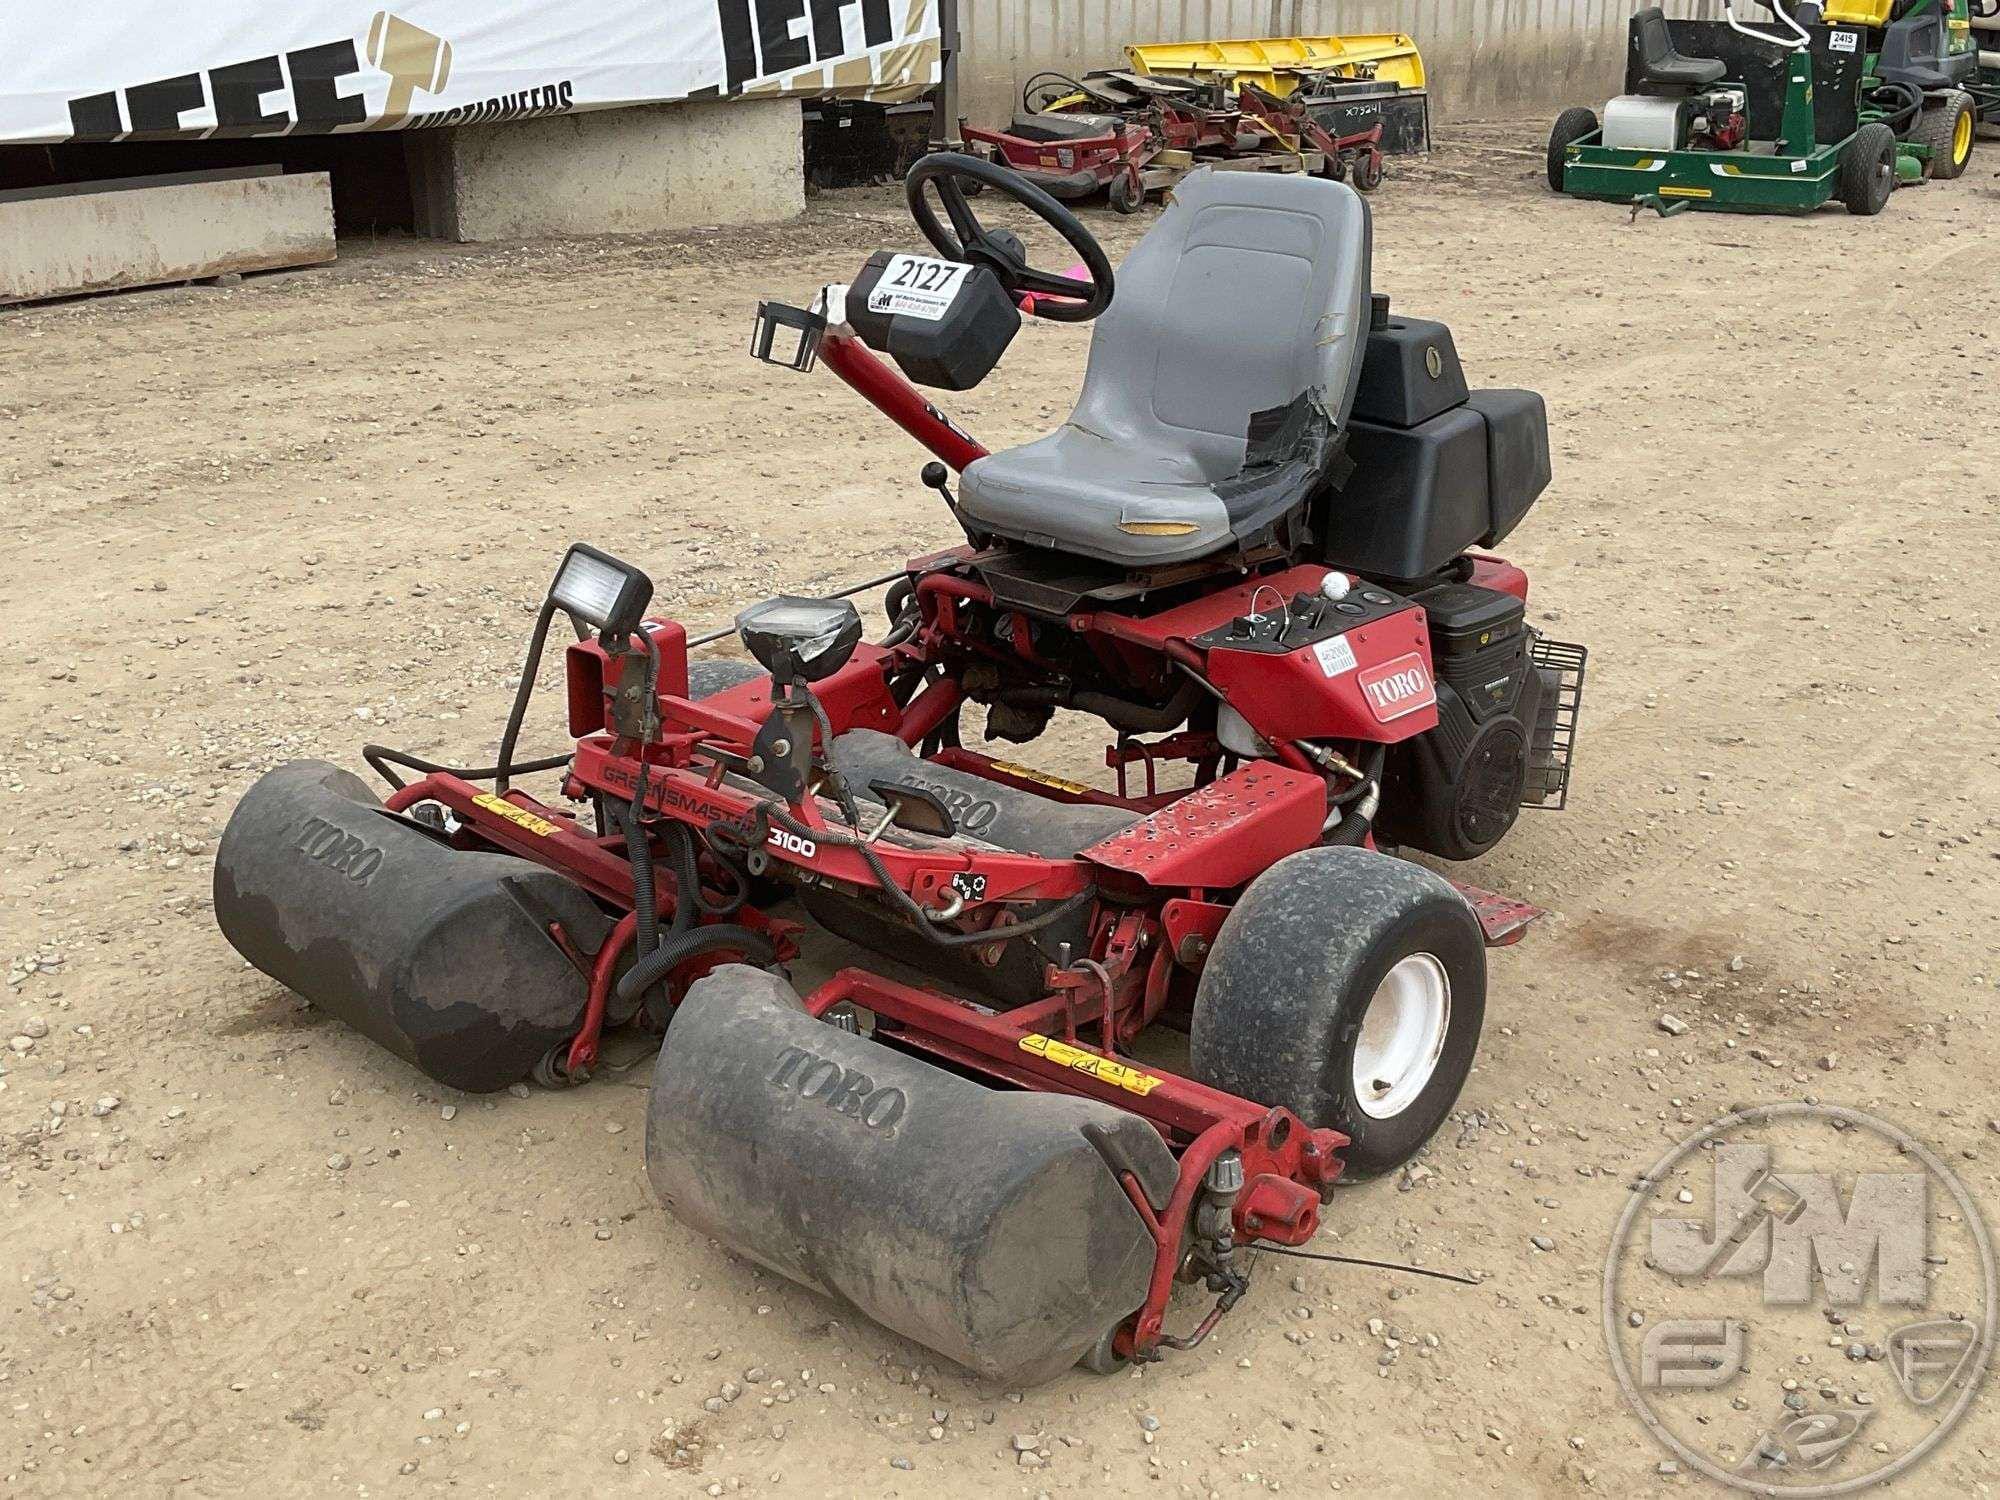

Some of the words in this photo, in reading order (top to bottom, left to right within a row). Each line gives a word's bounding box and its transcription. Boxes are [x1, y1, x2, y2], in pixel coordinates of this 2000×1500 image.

[1834, 33, 1853, 43] 2415
[891, 260, 959, 291] 2127
[1368, 669, 1425, 707] TORO
[899, 774, 997, 829] RO
[296, 816, 384, 882] TORO
[767, 826, 816, 858] 3100
[766, 1045, 907, 1129] TORO
